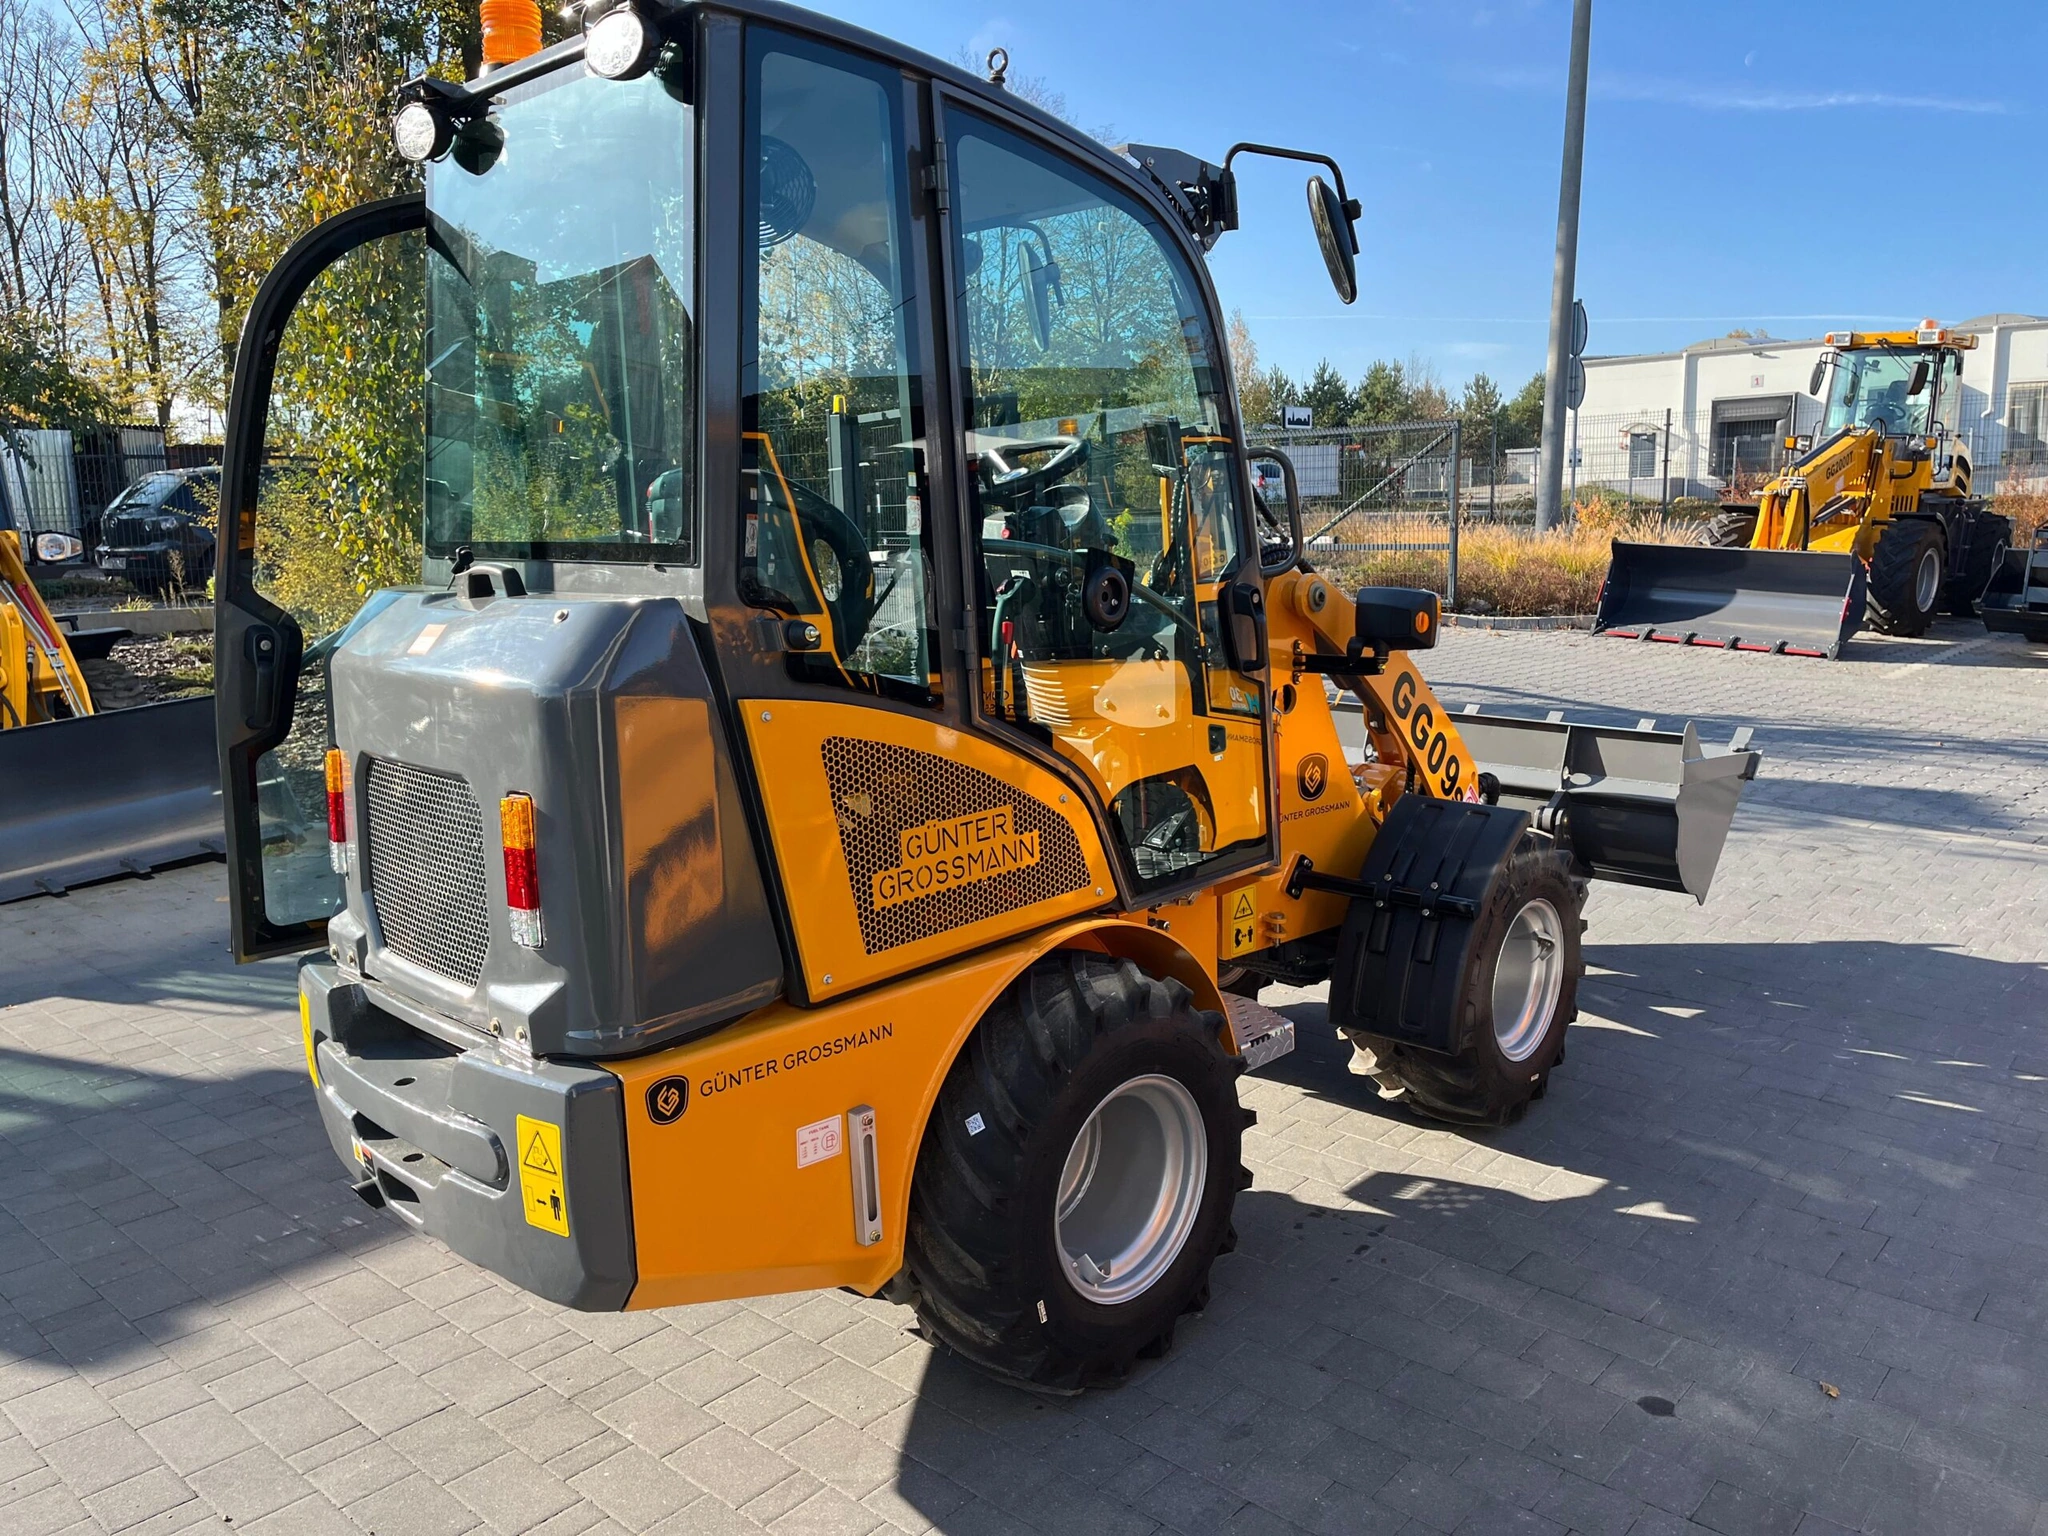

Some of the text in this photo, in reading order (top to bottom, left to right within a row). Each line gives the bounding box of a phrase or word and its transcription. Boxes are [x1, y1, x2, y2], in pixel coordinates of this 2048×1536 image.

[1305, 800, 1350, 817] GROSSMANN
[906, 812, 1008, 859] GÜNTER
[878, 835, 1035, 899] GROSSMANN
[700, 1022, 893, 1097] GÜNTER GROSSMANN
[809, 1127, 819, 1135] FUEL
